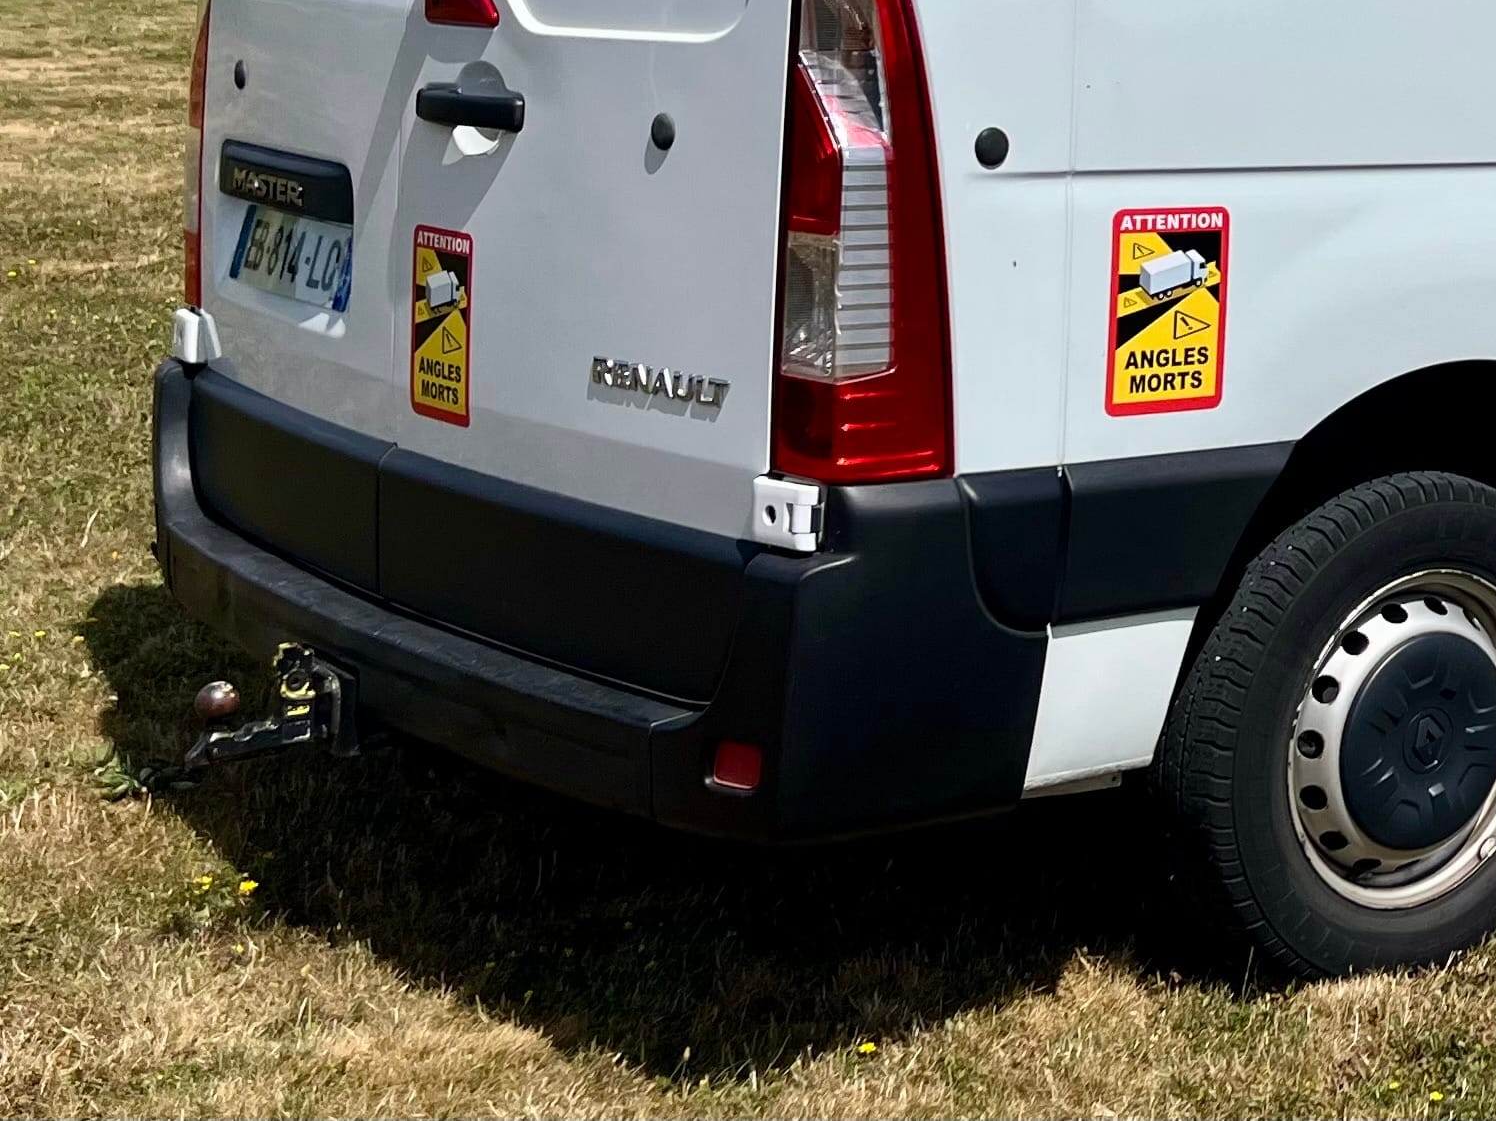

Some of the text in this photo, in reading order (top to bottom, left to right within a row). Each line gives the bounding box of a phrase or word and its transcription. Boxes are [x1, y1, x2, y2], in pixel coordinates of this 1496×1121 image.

[232, 167, 304, 207] MASTER
[1120, 212, 1224, 231] ATTENTION
[416, 230, 470, 255] ATTENTION
[418, 356, 462, 383] ANGLES
[1125, 346, 1209, 370] ANGLES
[421, 379, 459, 406] MORTS
[592, 356, 730, 408] RENAULT
[1129, 370, 1203, 394] MORTS
